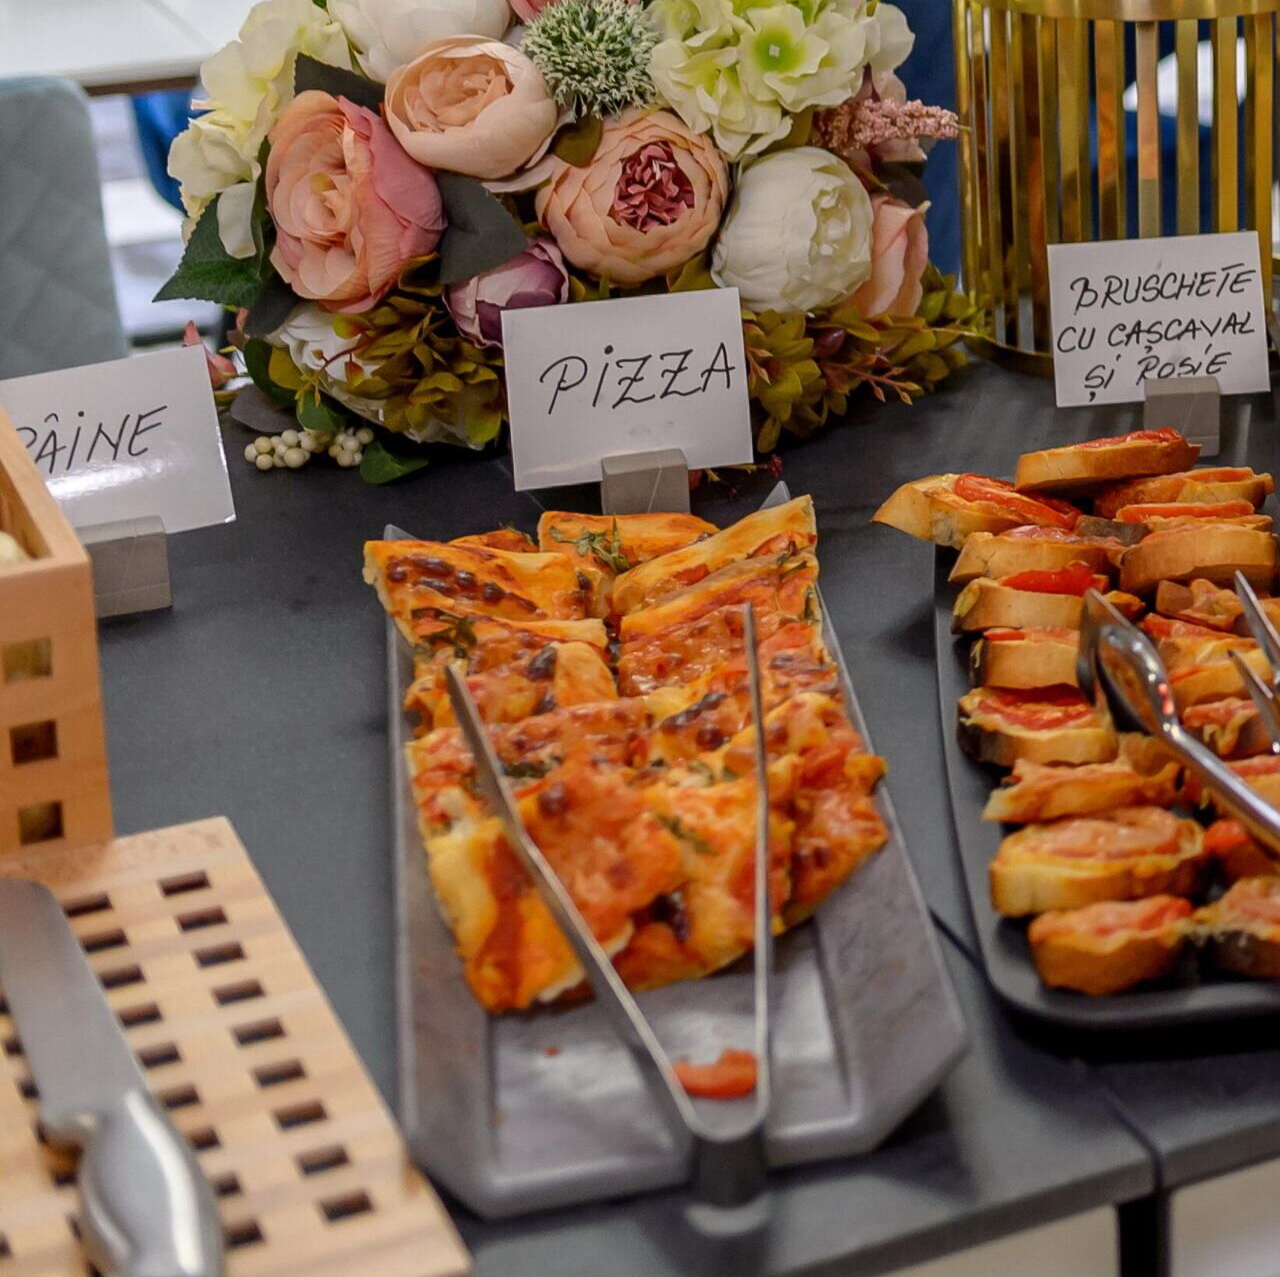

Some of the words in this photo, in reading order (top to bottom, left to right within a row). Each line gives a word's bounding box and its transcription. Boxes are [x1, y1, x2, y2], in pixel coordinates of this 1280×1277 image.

[1069, 262, 1257, 315] BRUSCHETE
[1056, 326, 1096, 353] CU
[539, 341, 736, 415] PIZZA
